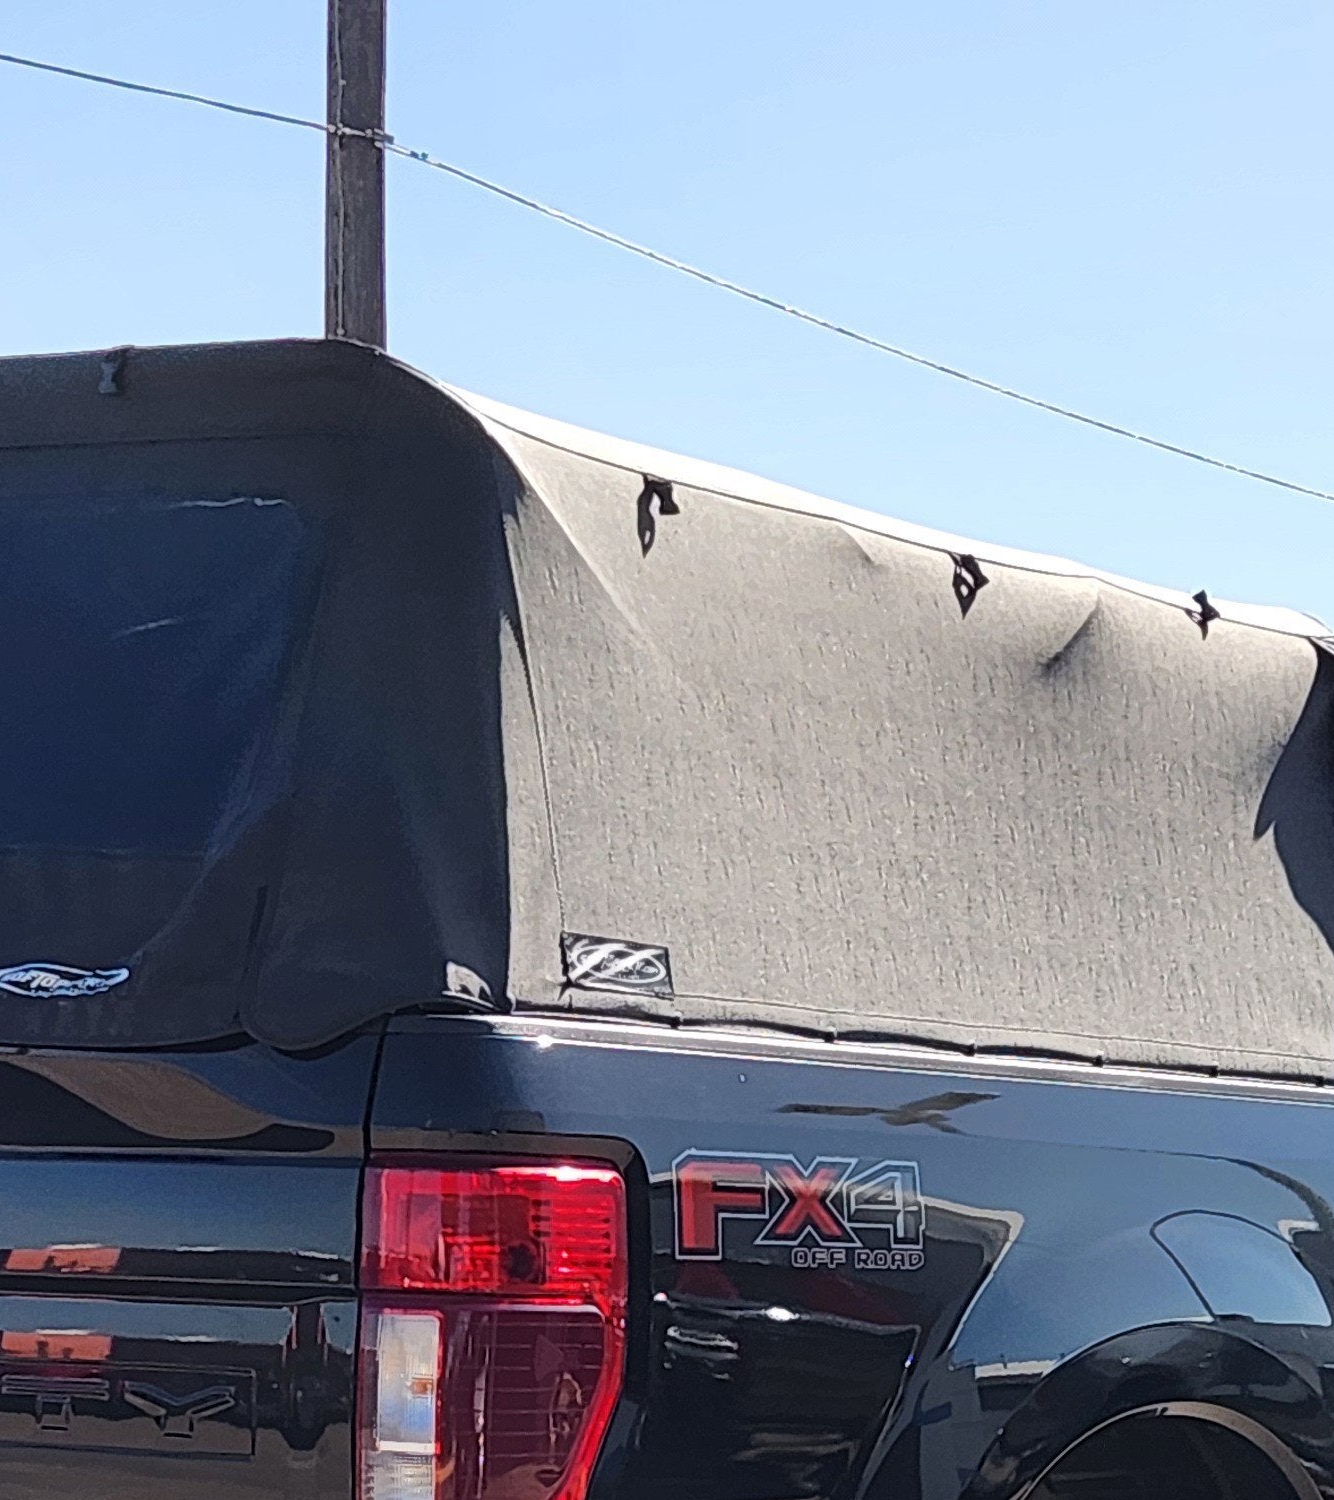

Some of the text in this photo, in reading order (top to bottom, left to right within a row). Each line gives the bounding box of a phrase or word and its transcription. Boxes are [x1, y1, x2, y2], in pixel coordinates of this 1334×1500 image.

[671, 1148, 926, 1261] FX4
[791, 1246, 925, 1270] OFF ROAD
